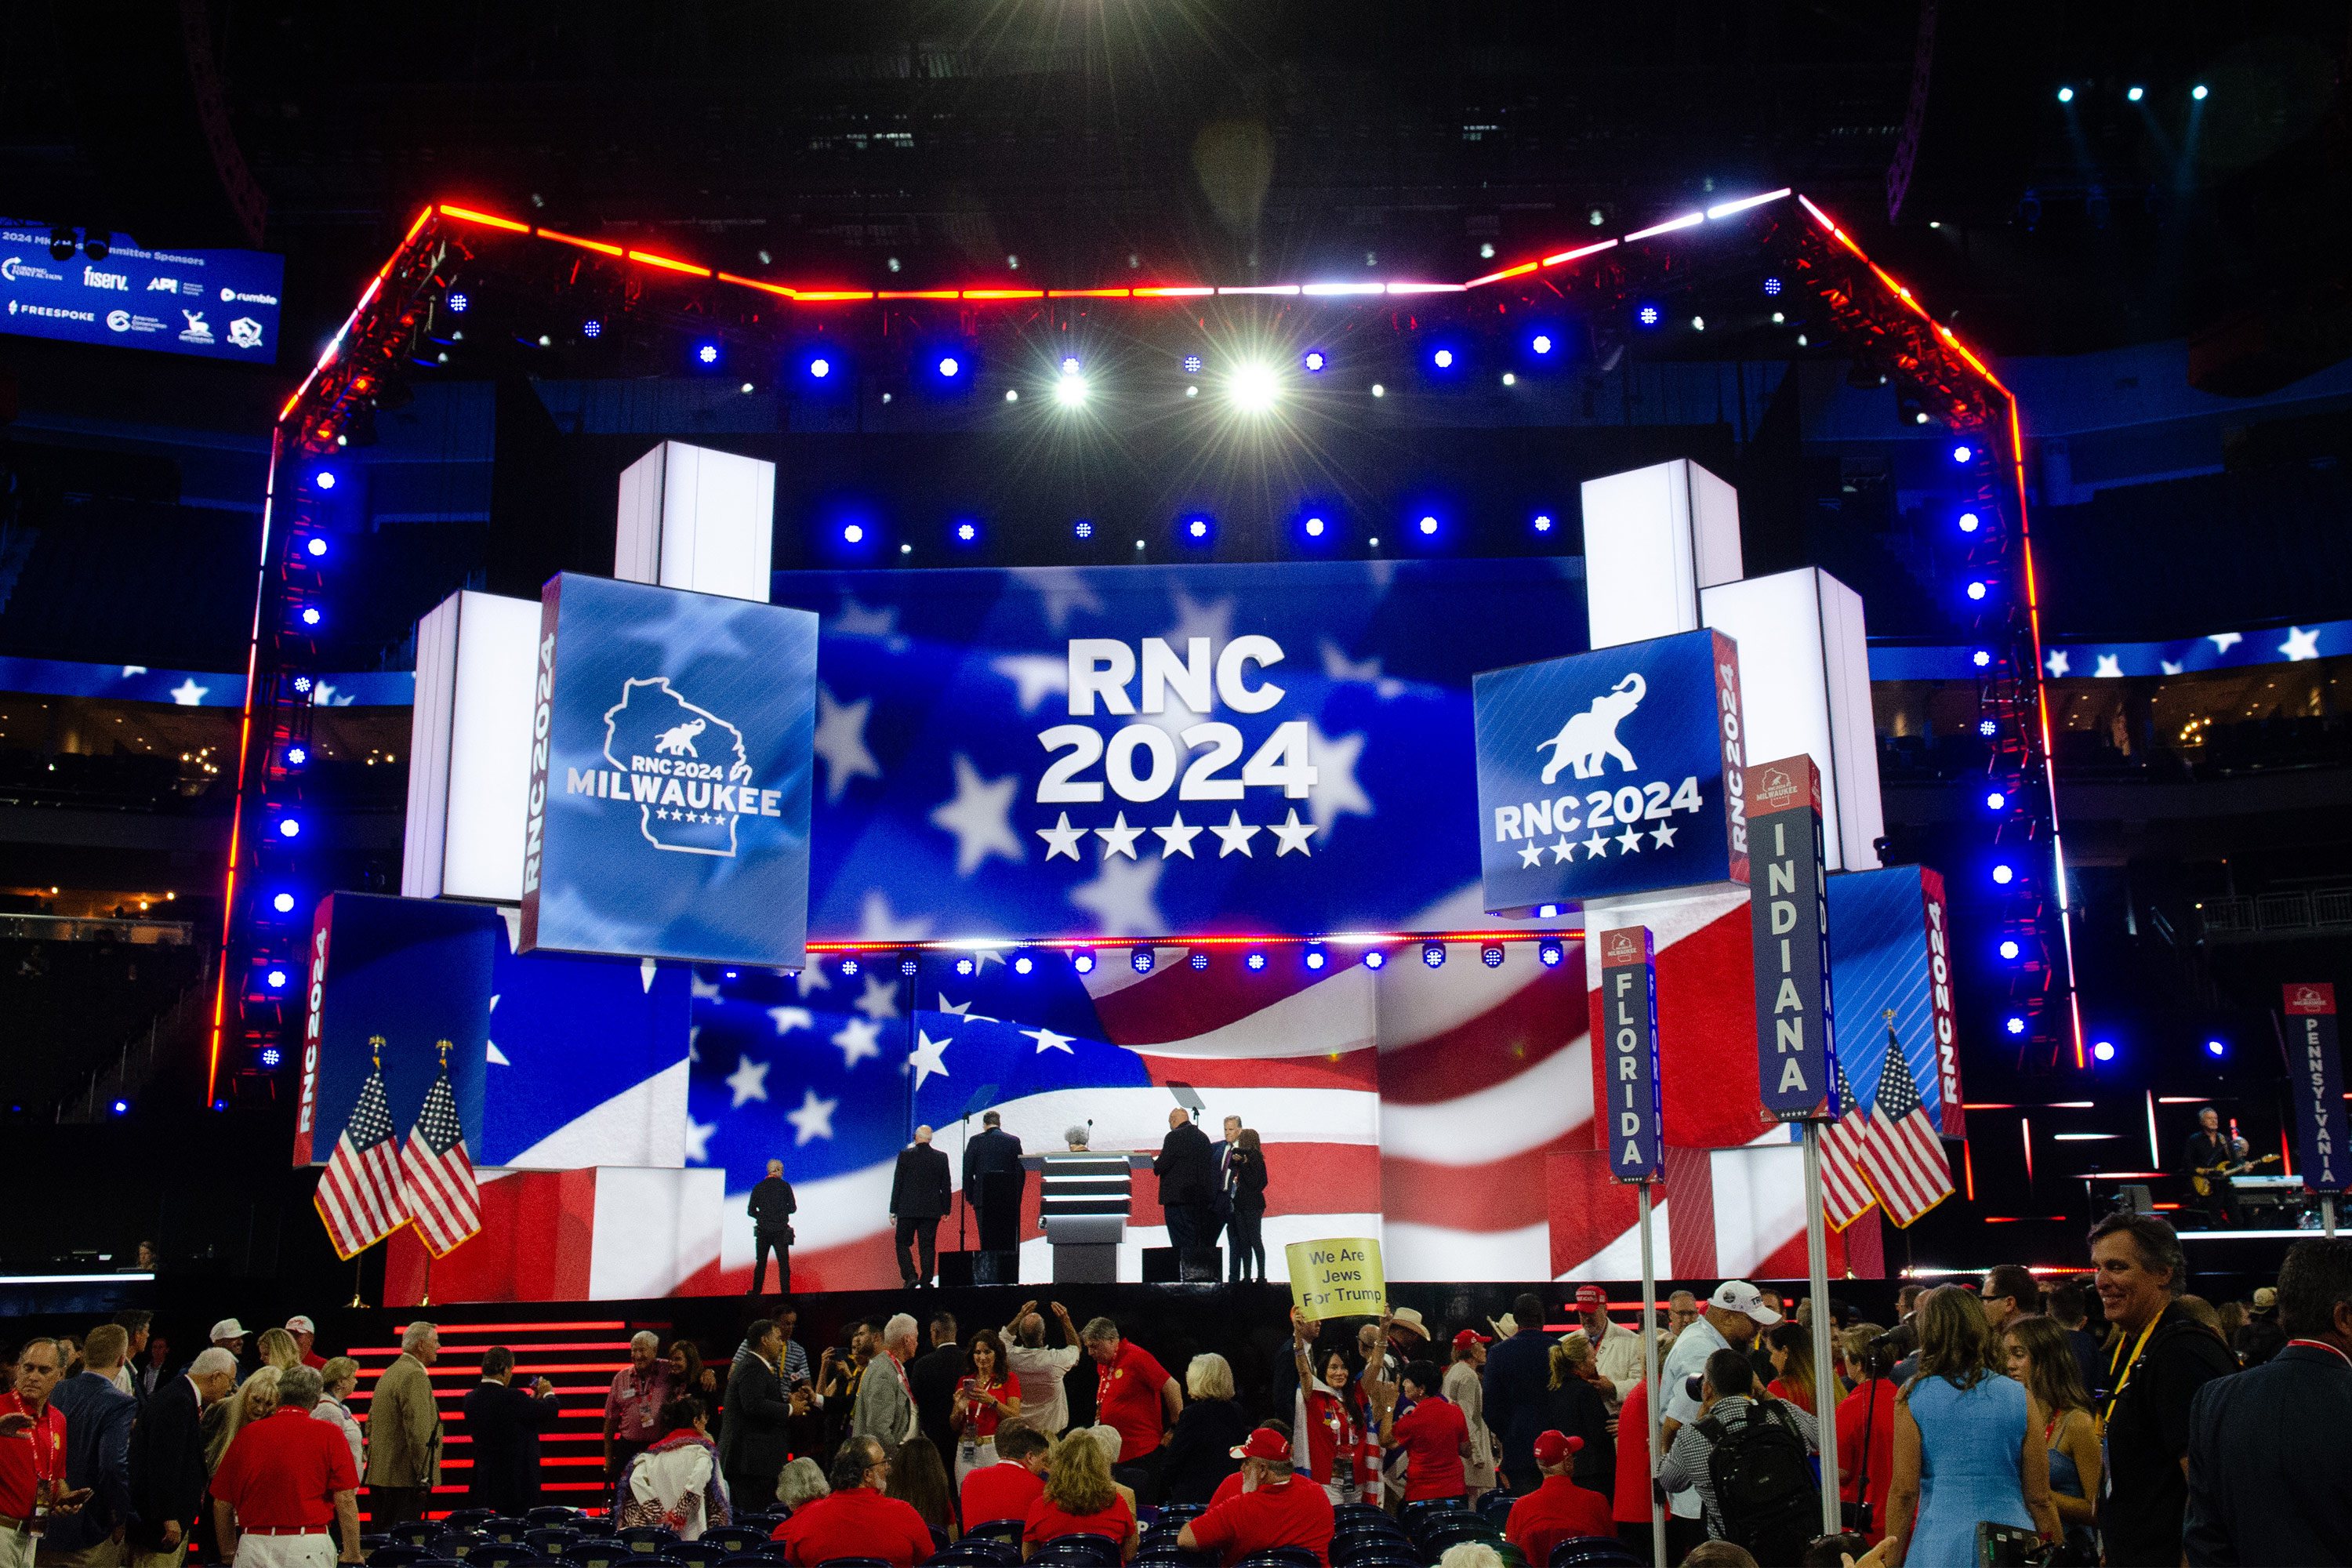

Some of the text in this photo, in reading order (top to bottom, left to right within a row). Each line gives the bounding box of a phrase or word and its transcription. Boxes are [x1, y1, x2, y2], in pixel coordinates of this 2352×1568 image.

[2, 232, 32, 243] 2024
[154, 252, 205, 266] Sponsors
[21, 304, 95, 322] FREESPOKE
[237, 292, 278, 305] rumble
[1069, 634, 1287, 716] RNC
[524, 633, 555, 895] RNC 2024
[567, 768, 781, 817] MILWAUKEE
[632, 755, 723, 781] RNC 2024
[1036, 720, 1319, 803] 2024
[1719, 663, 1748, 854] RNC 2024
[1756, 786, 1798, 801] MILWAUKEE
[1495, 776, 1703, 842] RNC 2024
[1769, 823, 1808, 1094] INDIANA
[1817, 824, 1837, 1095] INDIANA
[299, 927, 327, 1134] RNC 2024
[1929, 902, 1958, 1105] RNC 2024
[1616, 973, 1643, 1165] FLORIDA
[2306, 1018, 2336, 1182] PENNSYLVANIA
[1309, 1248, 1365, 1265] We Are
[1323, 1269, 1362, 1283] Jews
[1302, 1288, 1381, 1307] For Trump
